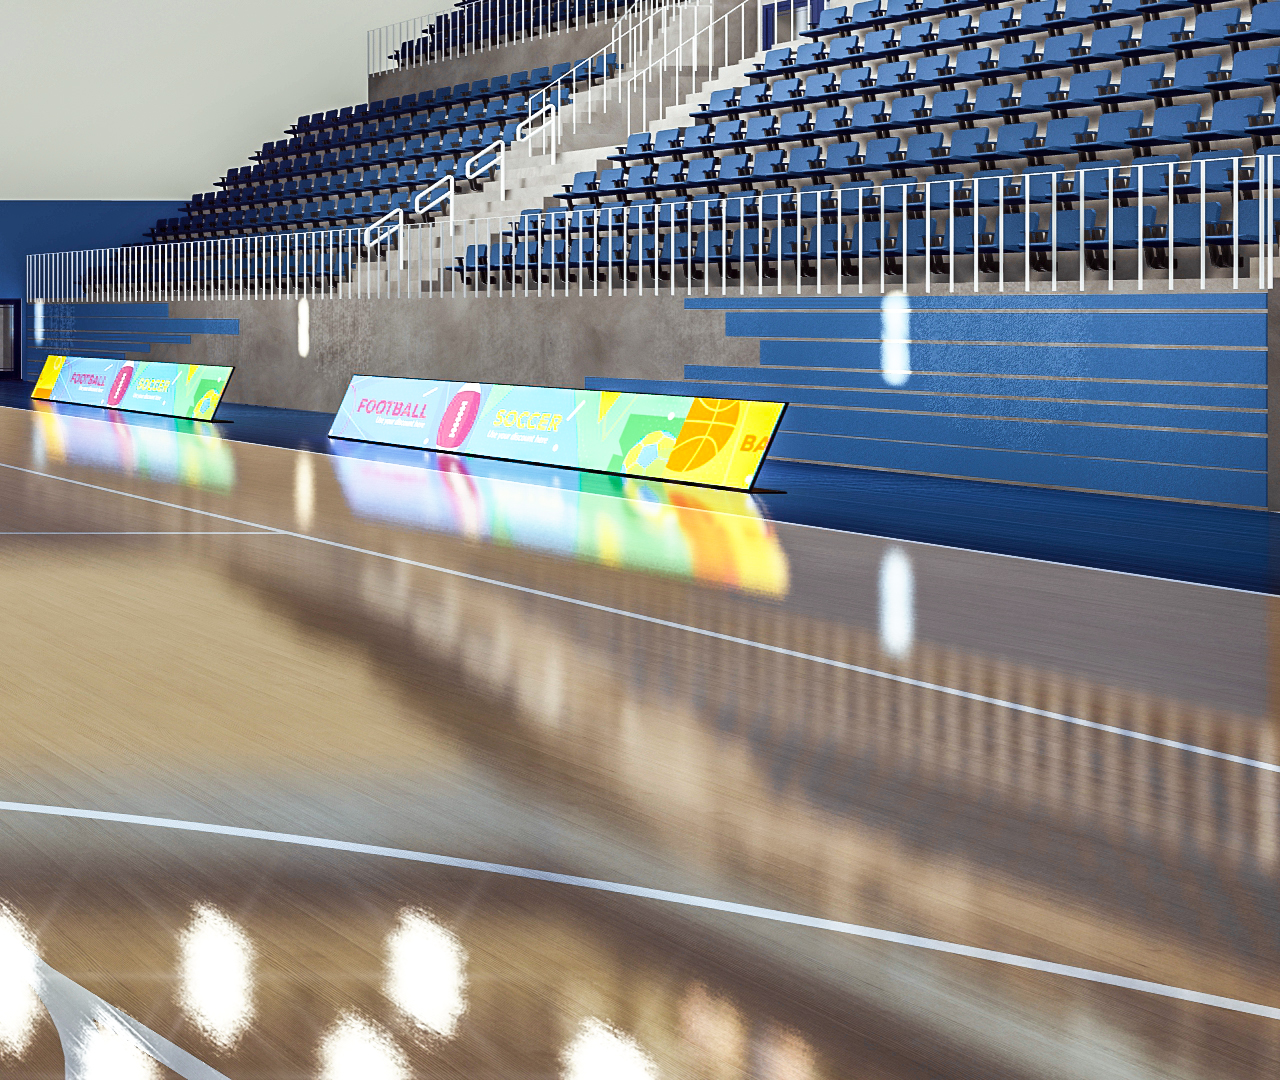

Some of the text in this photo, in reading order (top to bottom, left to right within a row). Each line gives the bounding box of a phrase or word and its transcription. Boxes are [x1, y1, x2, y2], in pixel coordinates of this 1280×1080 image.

[357, 398, 427, 418] FOOTBALL
[493, 409, 562, 432] SOCCER
[740, 434, 769, 452] BA
